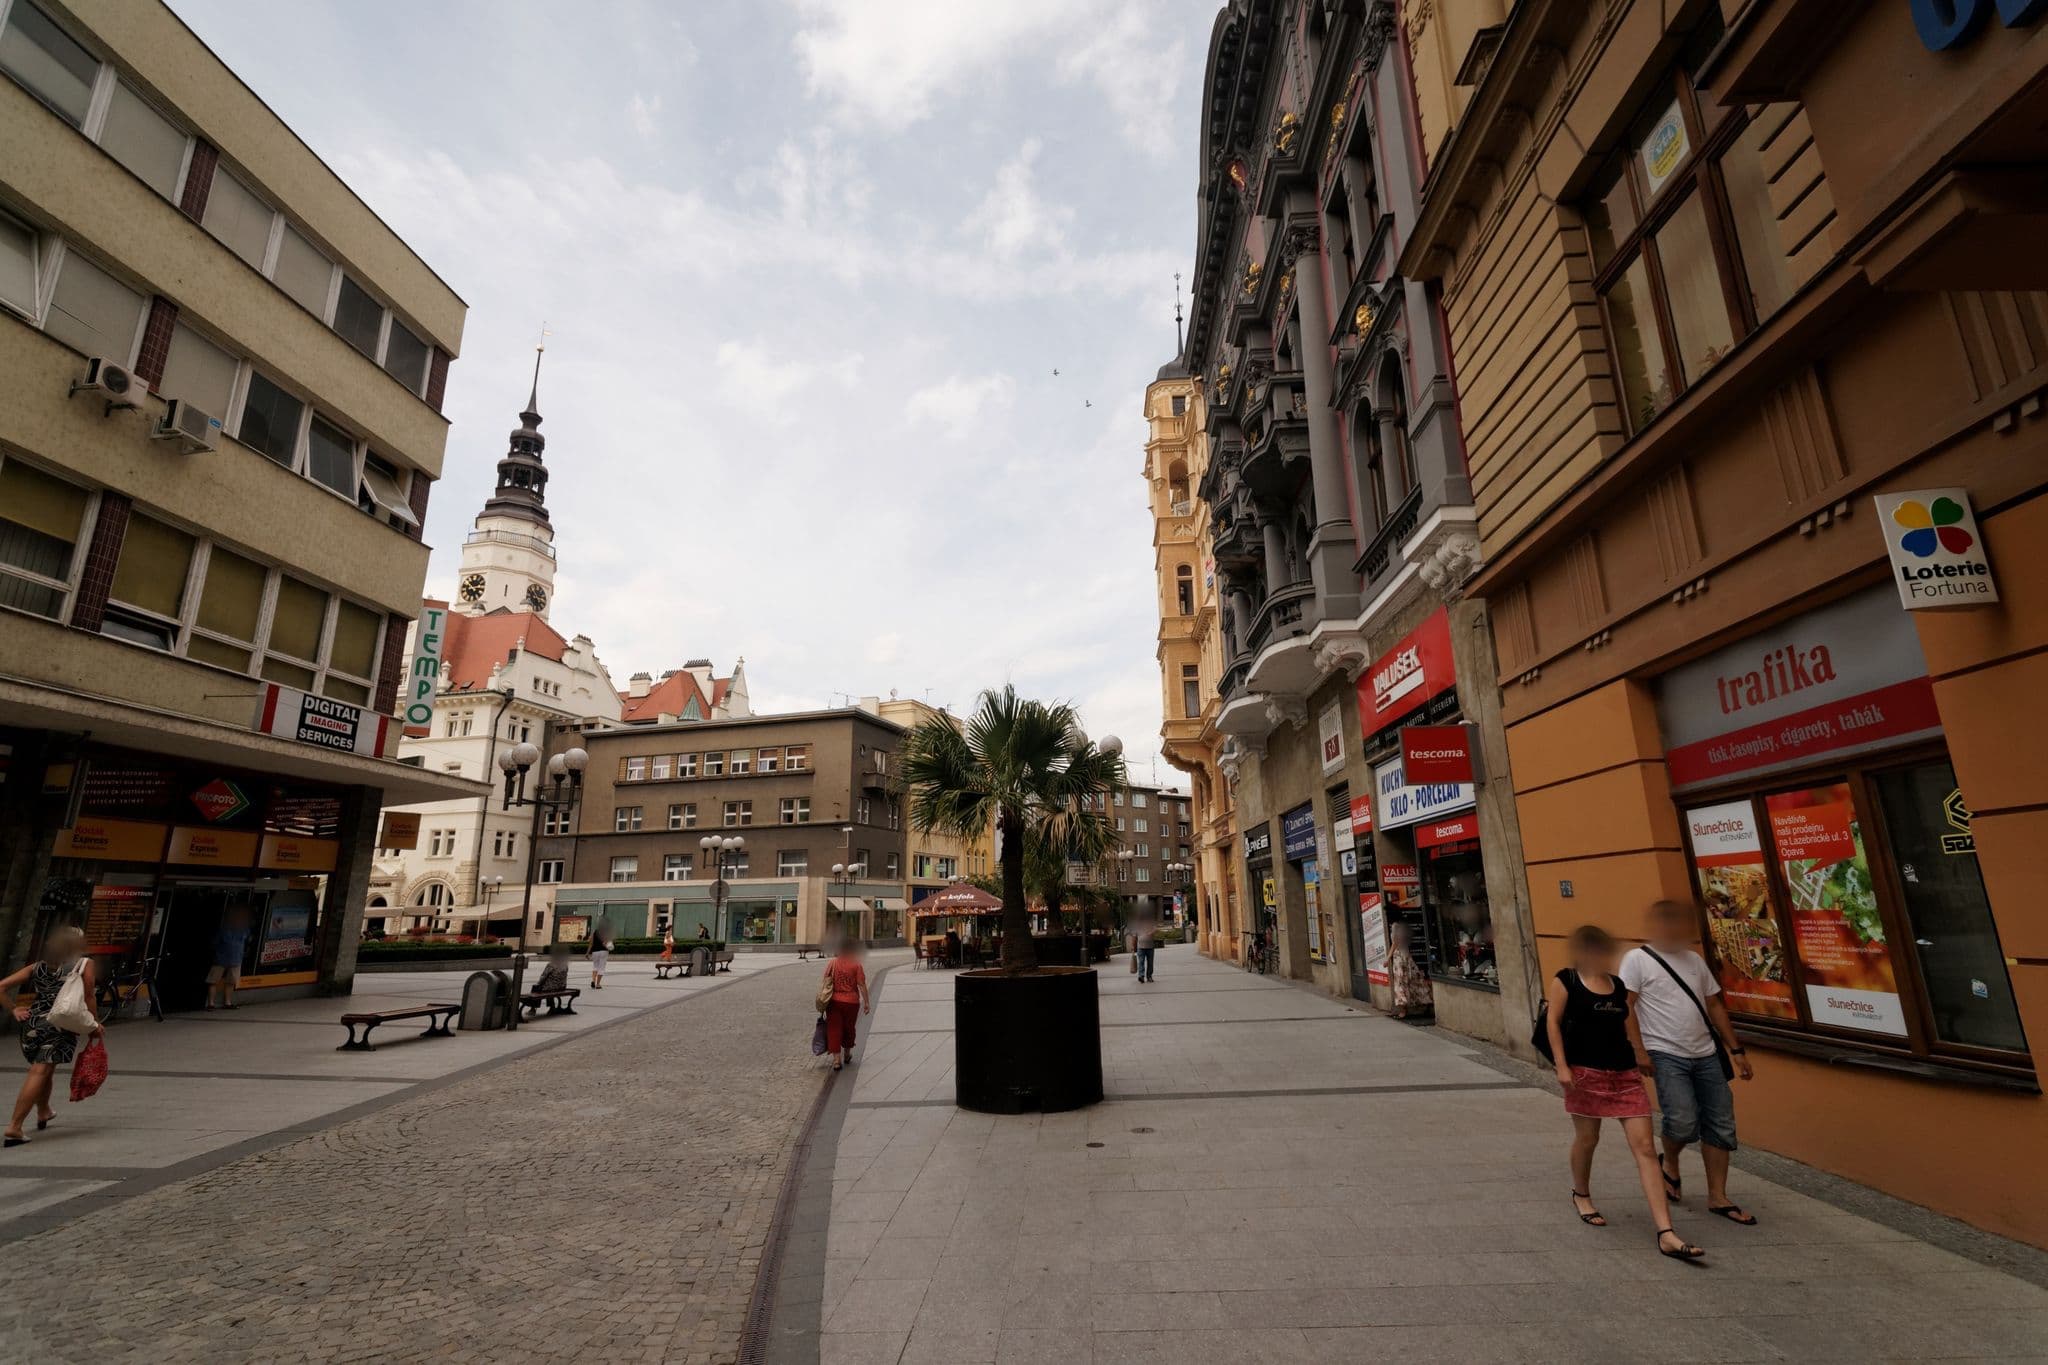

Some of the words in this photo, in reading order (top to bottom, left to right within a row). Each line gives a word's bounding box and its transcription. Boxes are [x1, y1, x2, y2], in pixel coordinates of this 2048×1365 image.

[1901, 561, 1987, 581] Loterie
[1909, 581, 1989, 599] Fortuna
[407, 610, 442, 724] TEMPO
[1373, 644, 1421, 697] VALUŠEK
[1717, 643, 1837, 715] trafika
[304, 695, 358, 722] DIGITAL
[1838, 703, 1885, 732] tabák
[310, 715, 348, 732] IMAGING
[298, 727, 353, 750] SERVICES
[194, 792, 237, 806] PROFOTO
[1390, 793, 1408, 819] SKLO
[1693, 818, 1744, 837] Slunečnice
[1792, 824, 1825, 838] prodejnu
[72, 834, 109, 846] Express
[1778, 838, 1789, 847] na
[1831, 832, 1842, 842] ul.
[1842, 830, 1849, 841] 3
[1780, 847, 1805, 859] Opava
[948, 892, 975, 902] kofola
[1827, 997, 1874, 1013] Slunečnice
